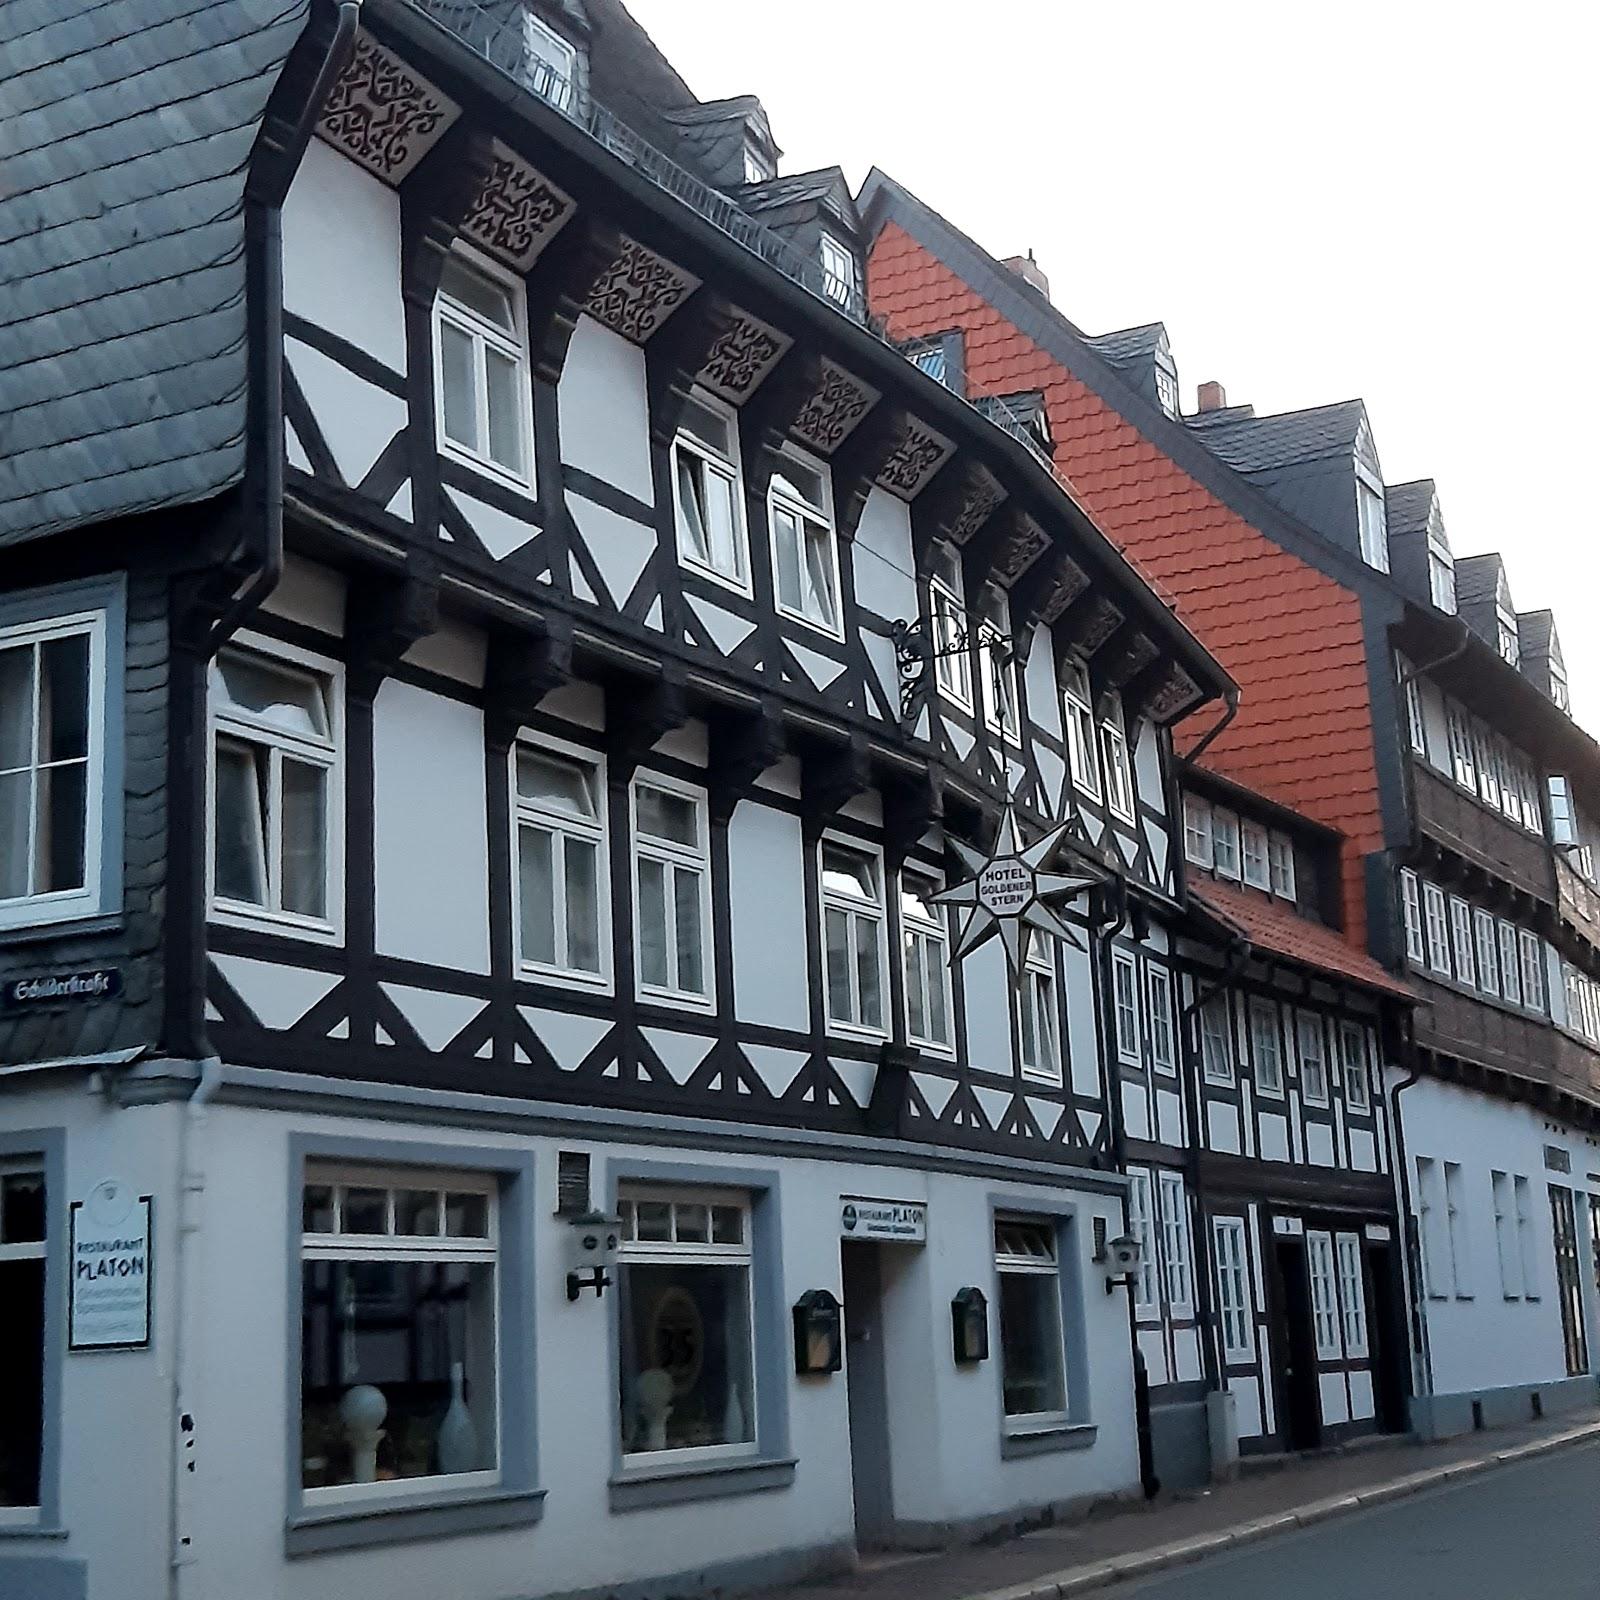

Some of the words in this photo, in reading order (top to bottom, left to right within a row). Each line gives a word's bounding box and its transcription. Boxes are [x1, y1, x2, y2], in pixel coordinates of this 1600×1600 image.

[985, 868, 1026, 882] HOTEL
[981, 882, 1032, 894] GOLDENER
[991, 895, 1024, 906] STERN
[893, 1207, 923, 1223] PLATON
[77, 1256, 144, 1281] PLATON
